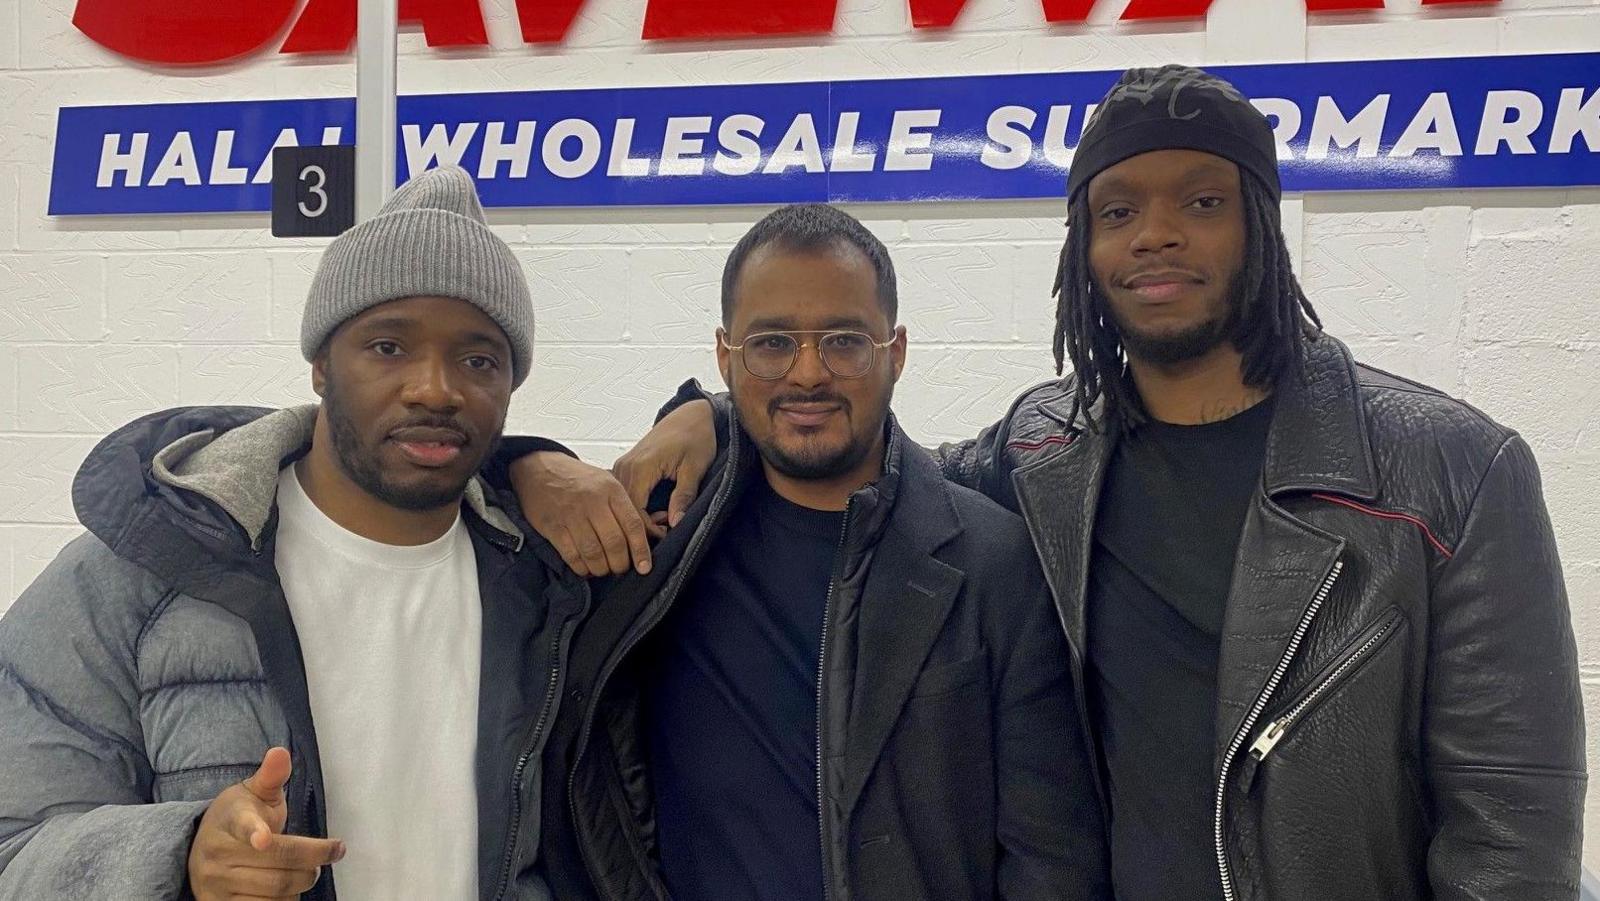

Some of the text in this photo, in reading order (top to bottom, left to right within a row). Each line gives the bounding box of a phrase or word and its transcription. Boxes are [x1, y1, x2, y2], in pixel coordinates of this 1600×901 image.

[97, 126, 343, 188] HALA
[402, 108, 942, 180] WHOLESALE
[298, 164, 329, 218] 3
